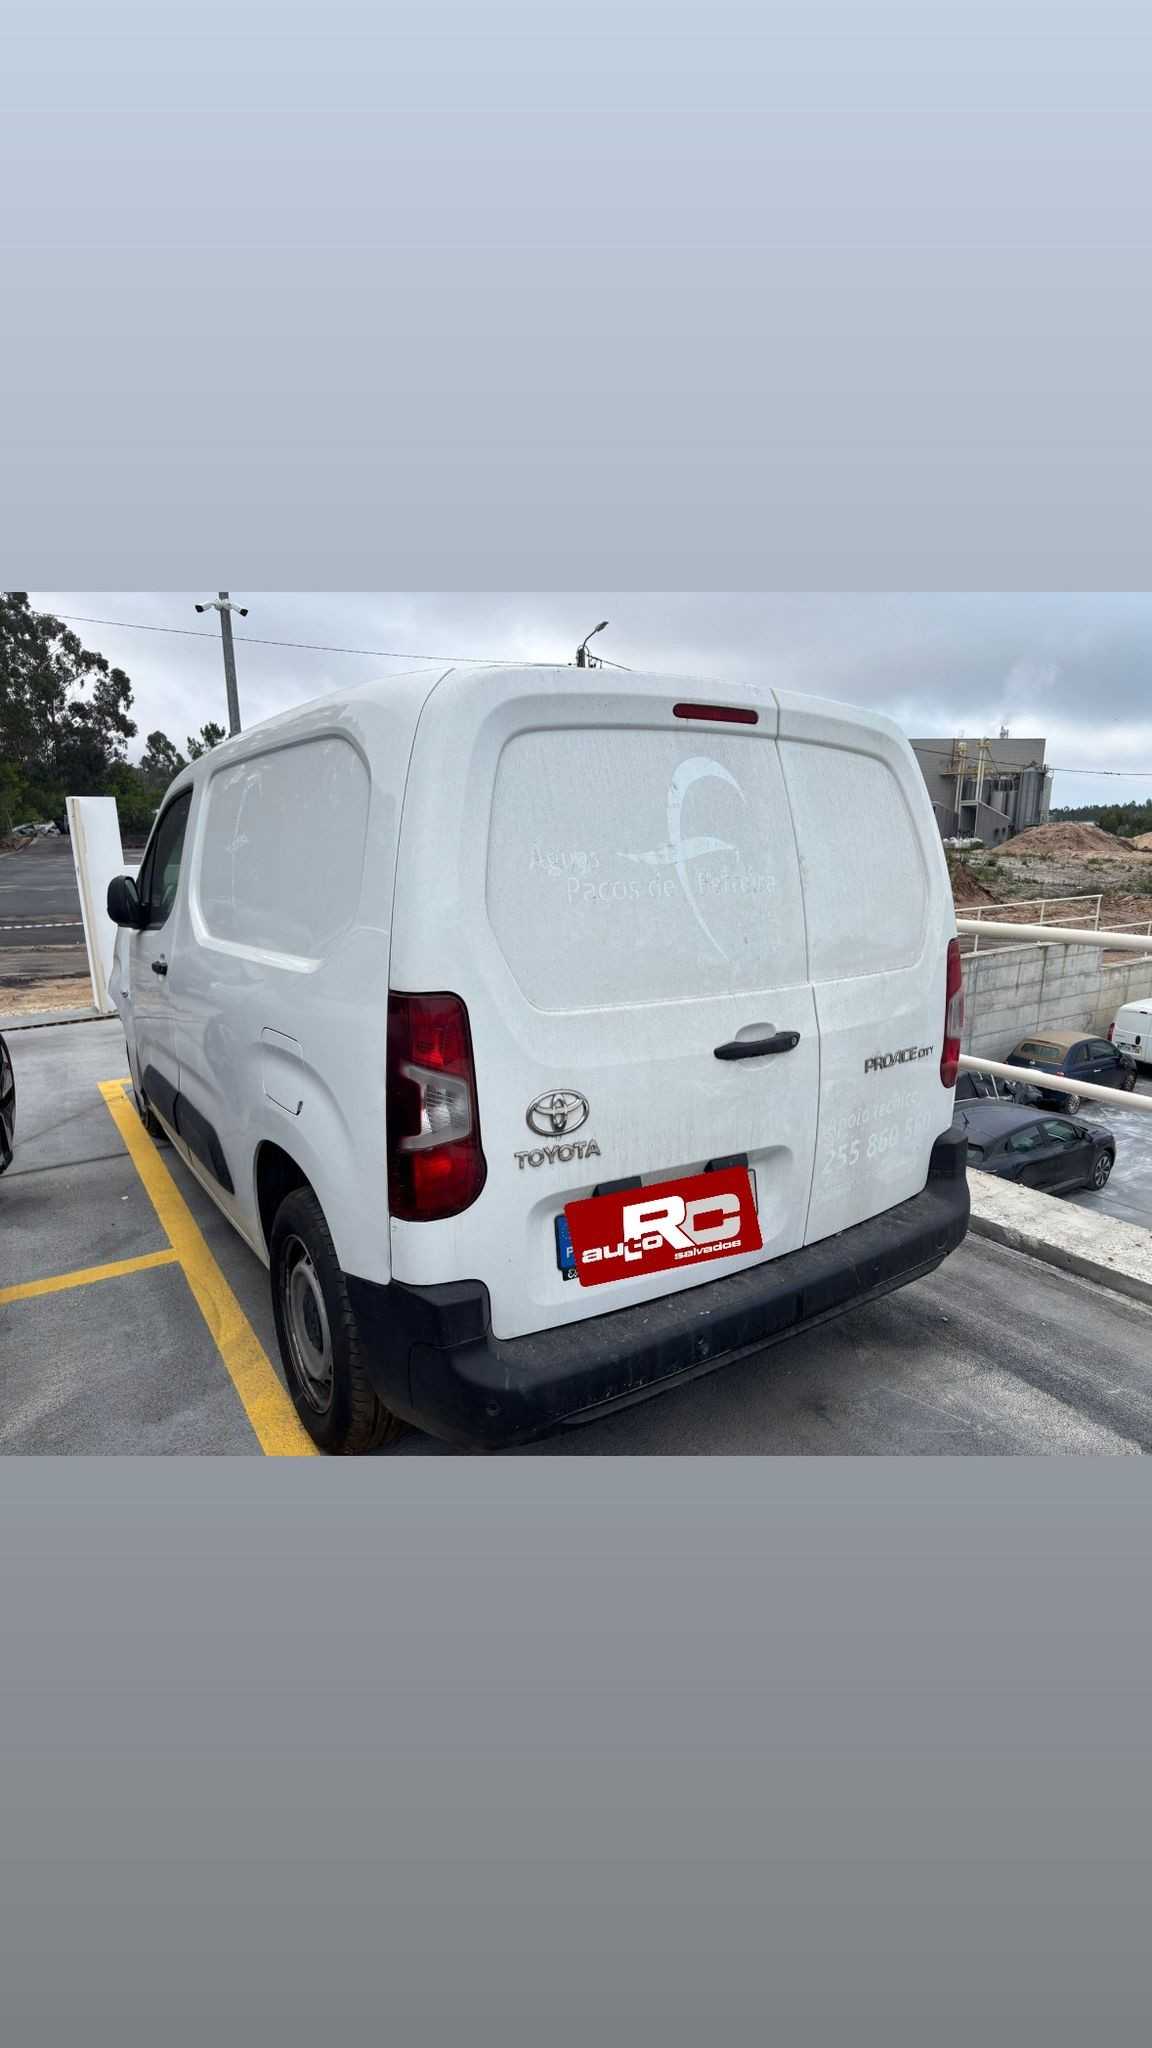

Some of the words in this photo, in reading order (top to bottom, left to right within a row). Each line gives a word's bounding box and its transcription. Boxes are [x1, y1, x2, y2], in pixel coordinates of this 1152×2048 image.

[863, 1046, 918, 1074] PROACE
[918, 1045, 934, 1058] CITY
[514, 1139, 601, 1170] TOYOTA
[822, 1139, 860, 1174] 255
